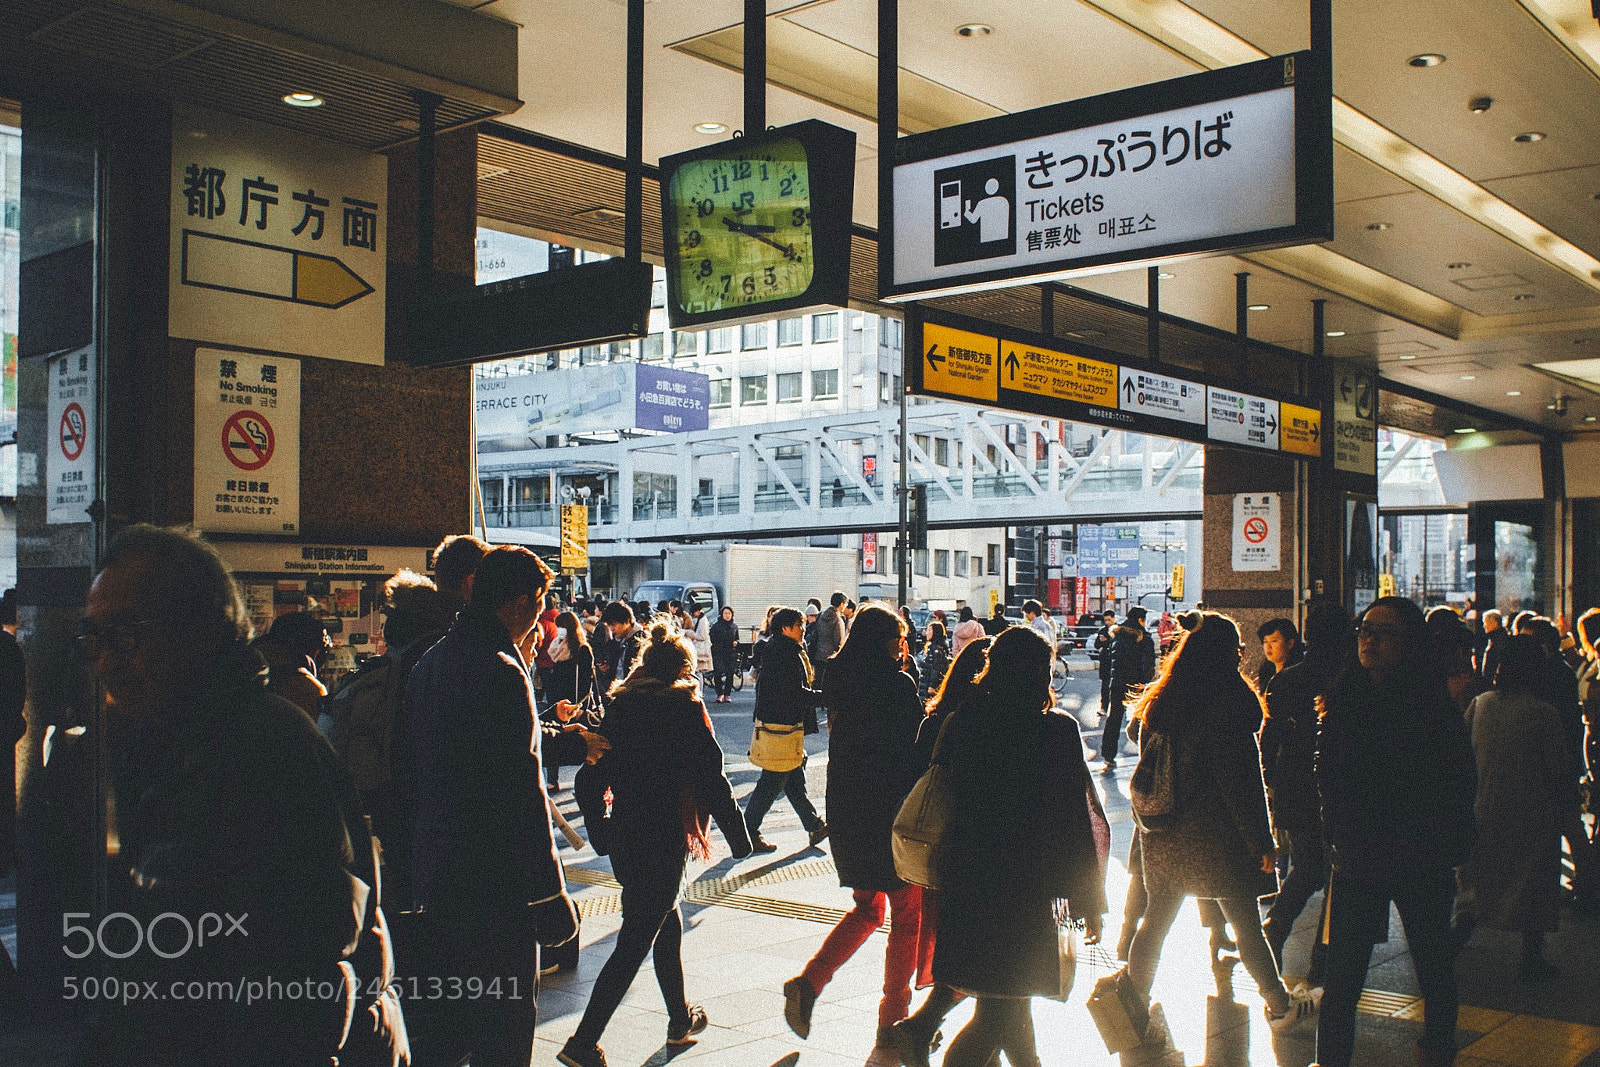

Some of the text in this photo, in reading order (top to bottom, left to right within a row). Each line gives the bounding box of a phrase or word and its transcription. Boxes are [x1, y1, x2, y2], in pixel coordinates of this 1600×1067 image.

[1024, 111, 1234, 189] きっぷうりば
[732, 162, 752, 182] 12
[760, 163, 770, 181] 1
[712, 175, 730, 194] 11
[780, 178, 793, 197] 2
[183, 163, 378, 252] 都庁方面
[1025, 192, 1104, 222] Tickets
[792, 208, 805, 227] 3
[1026, 213, 1157, 253] 售票处 매표소
[700, 259, 713, 277] 8
[764, 267, 776, 286] 5
[720, 275, 732, 293] 7
[742, 276, 755, 295] 6
[220, 380, 277, 397] No Smoking
[524, 394, 548, 406] CITY
[285, 561, 384, 571] Shinjuku Station Information
